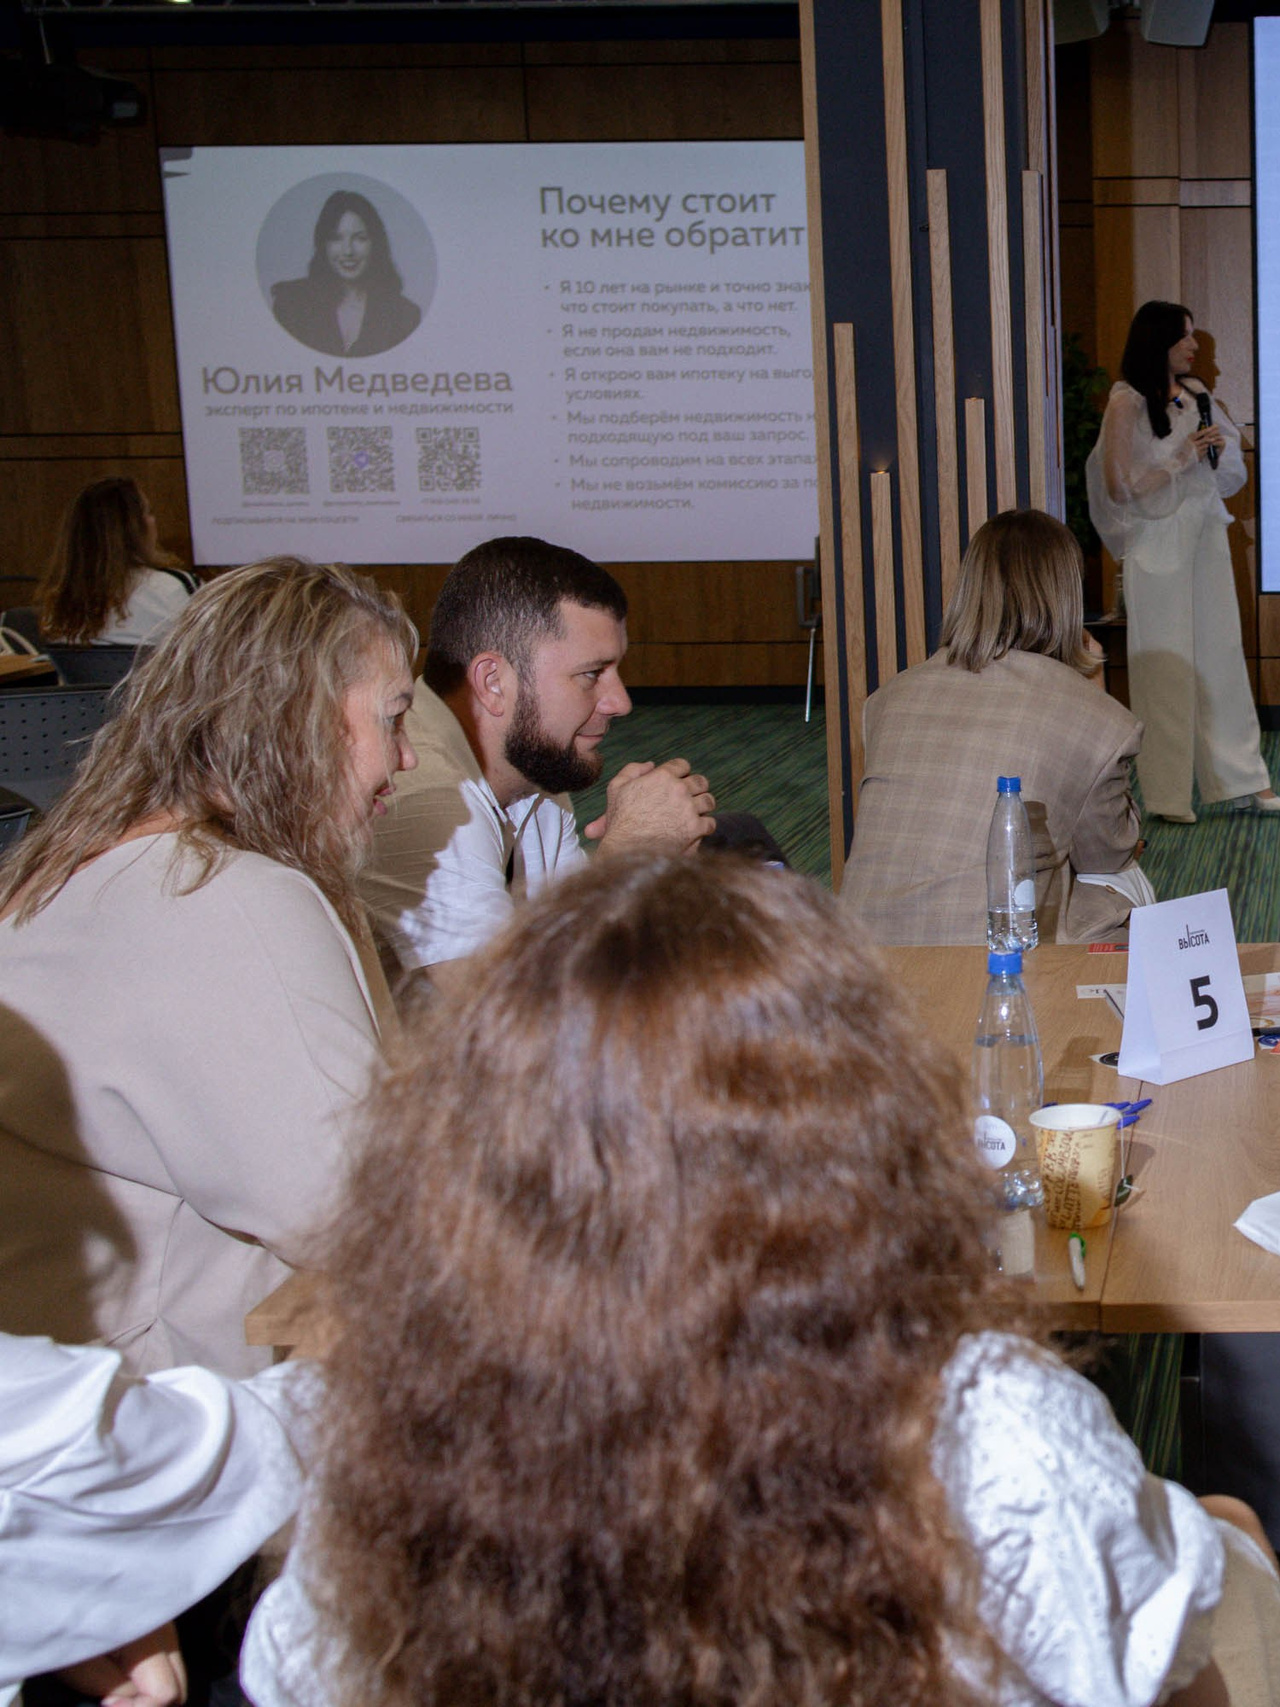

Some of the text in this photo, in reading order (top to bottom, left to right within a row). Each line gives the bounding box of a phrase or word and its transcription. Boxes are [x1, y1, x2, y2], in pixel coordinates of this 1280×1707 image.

[540, 186, 776, 222] Почему стоит
[542, 228, 580, 248] ко
[591, 228, 655, 247] мне
[202, 366, 513, 397] Юлия Медведева
[1178, 924, 1211, 950] ВЫСОТА
[1189, 974, 1219, 1031] 5
